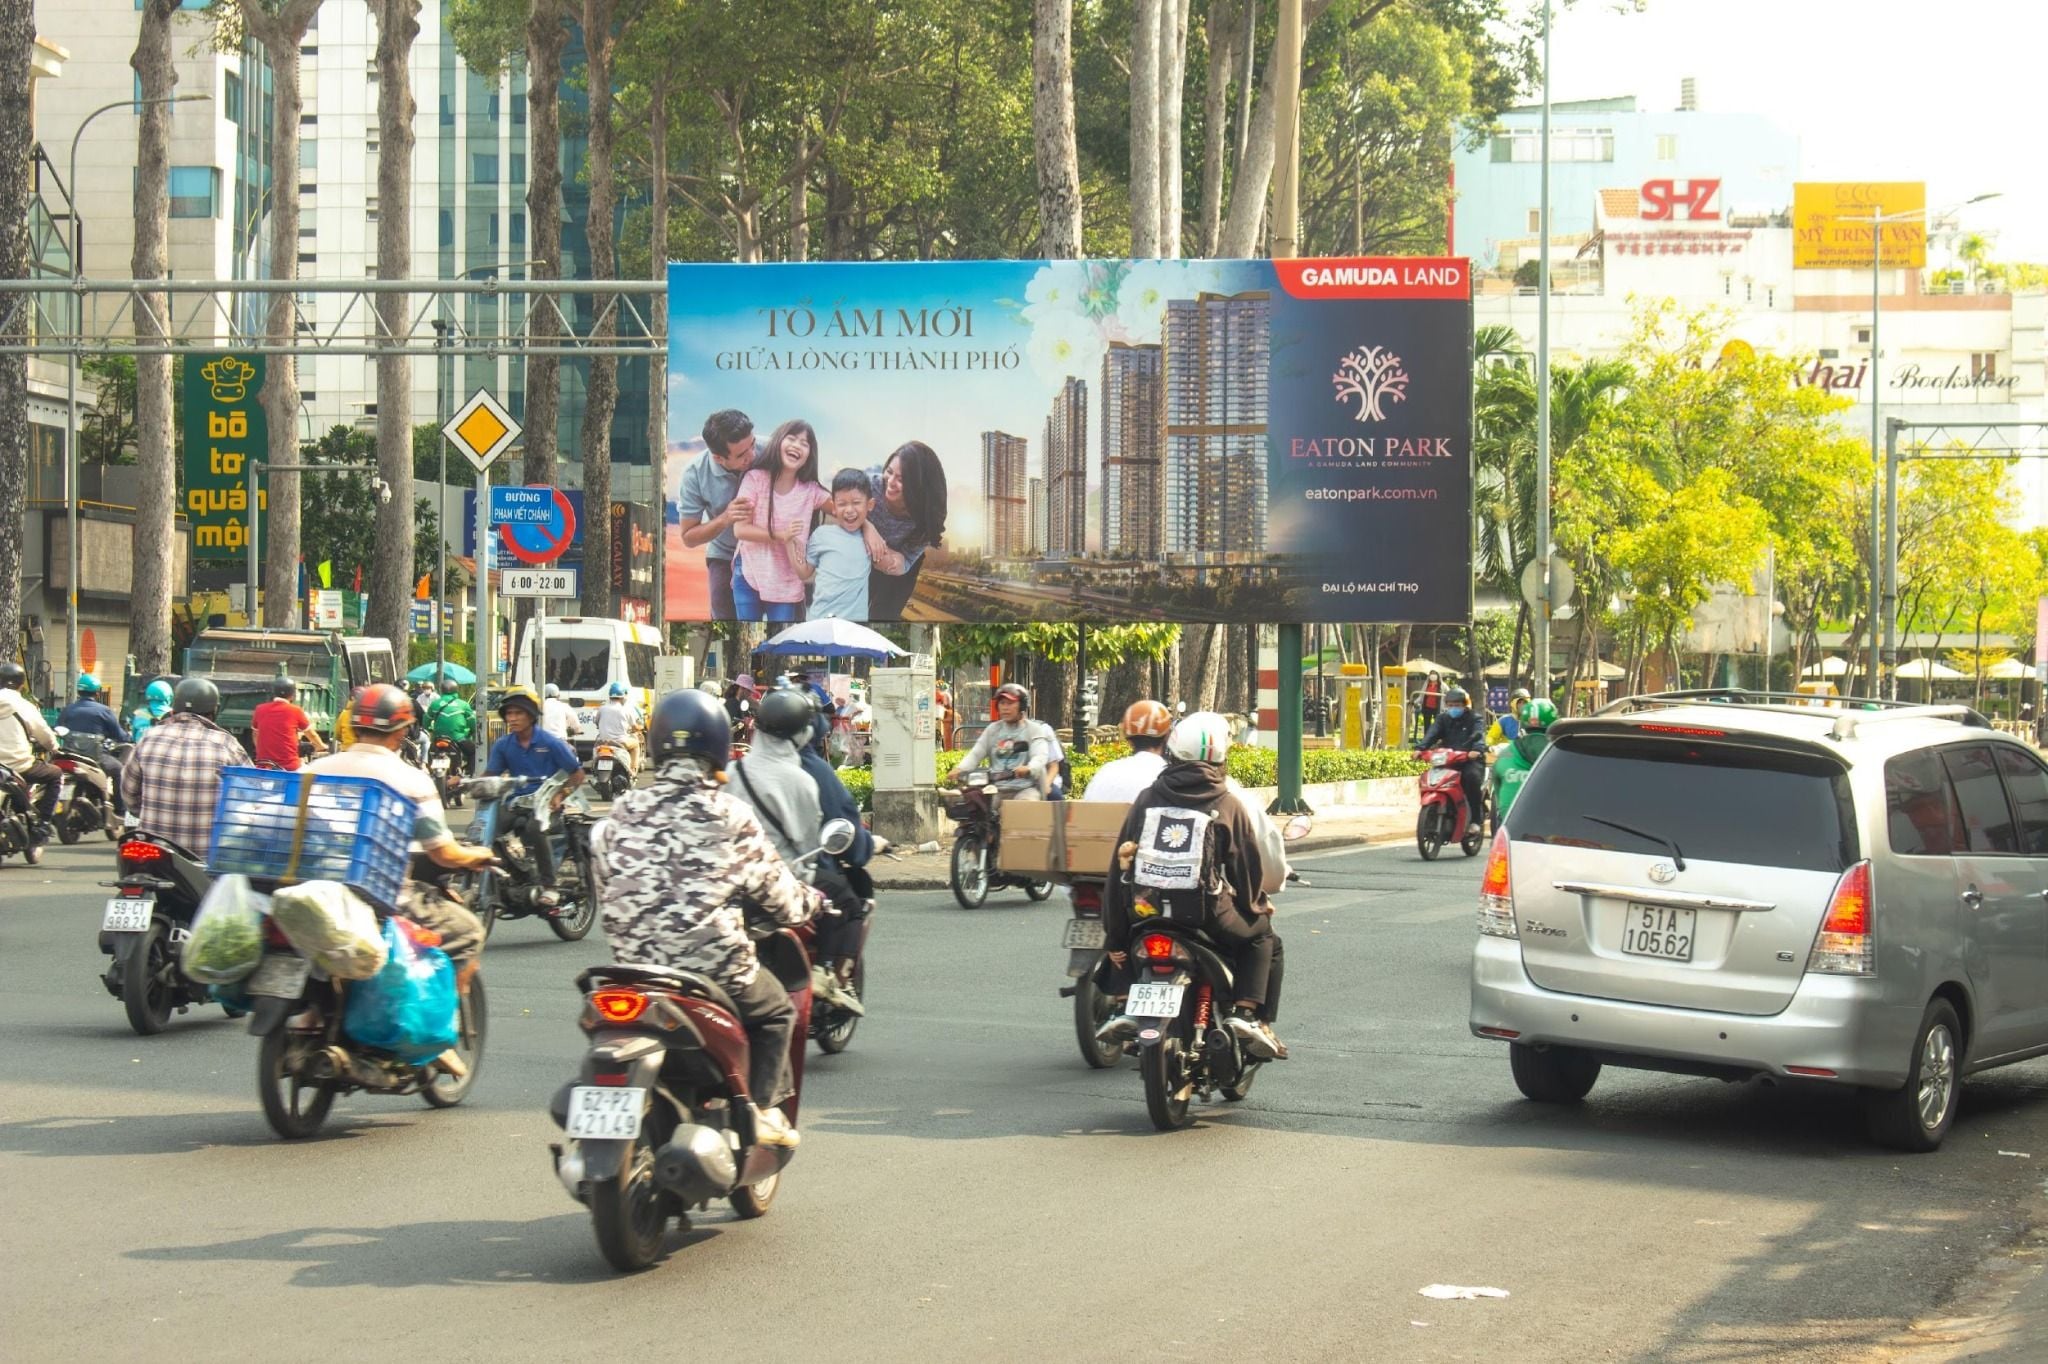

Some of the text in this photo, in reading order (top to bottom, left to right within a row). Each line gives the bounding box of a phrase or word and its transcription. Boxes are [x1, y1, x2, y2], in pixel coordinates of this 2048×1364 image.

[1641, 178, 1722, 222] SHZ
[1301, 267, 1460, 286] GAMUDA LAND
[758, 296, 974, 337] TỔ ẤM MỚI
[715, 342, 1020, 370] GIỮA LÒNG THÀNH PHỐ
[1890, 362, 2021, 390] Bookstore
[1290, 437, 1452, 457] EATON PARK
[211, 447, 245, 475] tơ
[505, 491, 541, 503] ĐƯỜNG
[1305, 486, 1438, 502] eatonpark.com.vn
[1322, 582, 1419, 594] ĐẠI LỘ MAI CHÍ THỌ
[1642, 907, 1677, 932] 51A
[1627, 929, 1689, 958] 105.62
